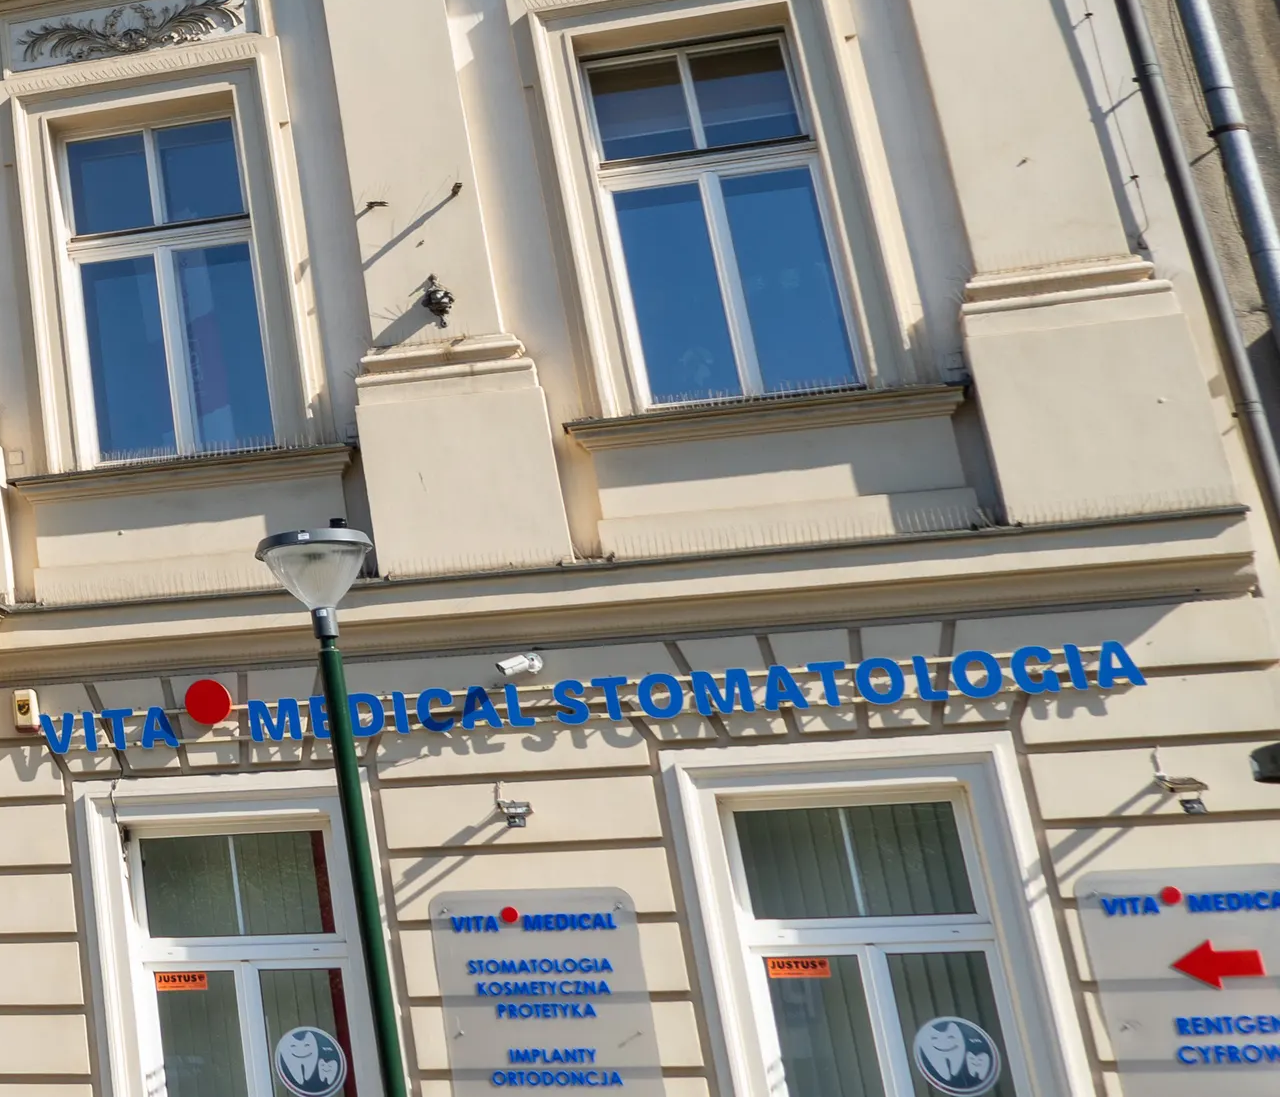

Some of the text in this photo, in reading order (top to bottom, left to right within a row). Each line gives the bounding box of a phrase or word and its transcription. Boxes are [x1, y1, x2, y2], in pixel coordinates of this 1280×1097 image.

[39, 640, 1147, 754] VITA MEDICAL STOMATOLOGIA
[1102, 896, 1160, 916] VITA
[450, 912, 618, 933] VITA MEDICAL
[467, 957, 614, 975] STOMATOLOGIA
[770, 960, 817, 969] JUSTUS
[158, 974, 198, 983] JUSTUS
[476, 980, 611, 997] KOSMETYCZNA
[496, 1003, 597, 1019] PROTETYKA
[508, 1048, 596, 1064] IMPLANTY
[491, 1070, 623, 1087] ORTODONCJA
